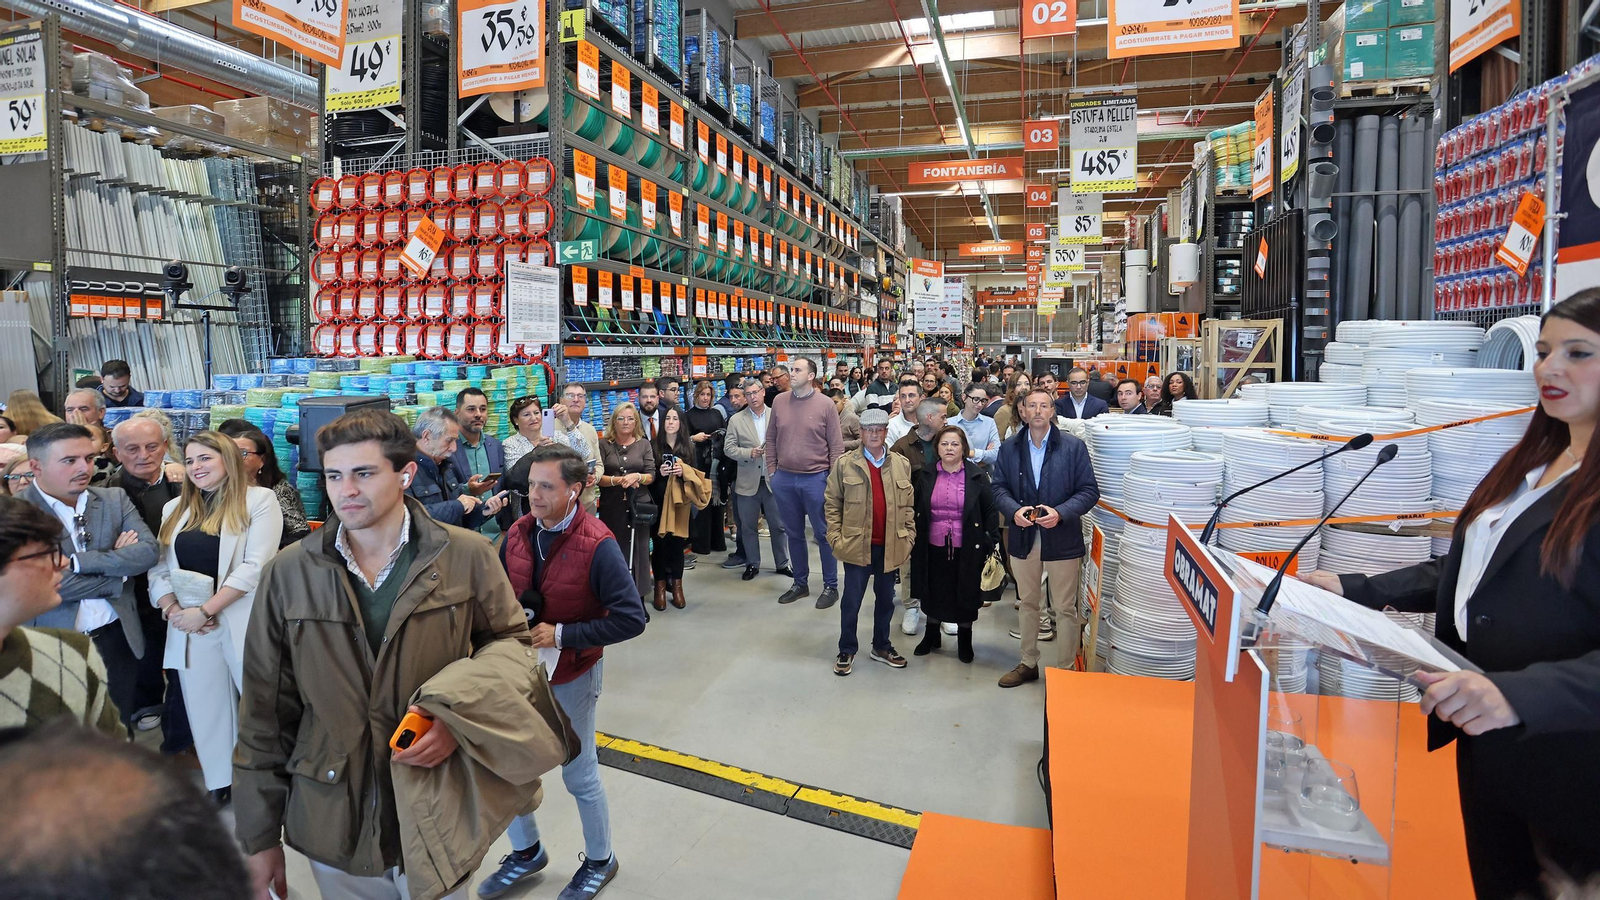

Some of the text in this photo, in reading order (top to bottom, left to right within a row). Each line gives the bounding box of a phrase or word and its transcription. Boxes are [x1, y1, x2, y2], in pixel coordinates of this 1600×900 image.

[1032, 1, 1067, 25] 02
[1199, 4, 1229, 15] INCLUIDO
[1179, 31, 1203, 40] PAGAR
[1204, 28, 1230, 38] MENOS
[318, 41, 337, 54] MENOS
[1070, 98, 1136, 108] UNIDADES LIMITADAS
[1071, 106, 1136, 125] ESTUFA PELLET
[1030, 128, 1053, 143] 03
[923, 163, 1007, 178] FONTANERÍA
[1030, 191, 1048, 202] 04
[1029, 228, 1043, 236] 05
[970, 245, 1011, 253] SANITARIO
[1029, 249, 1040, 257] 06
[1442, 420, 1471, 429] OBRAMAT
[1174, 549, 1217, 626] OBRAMAT
